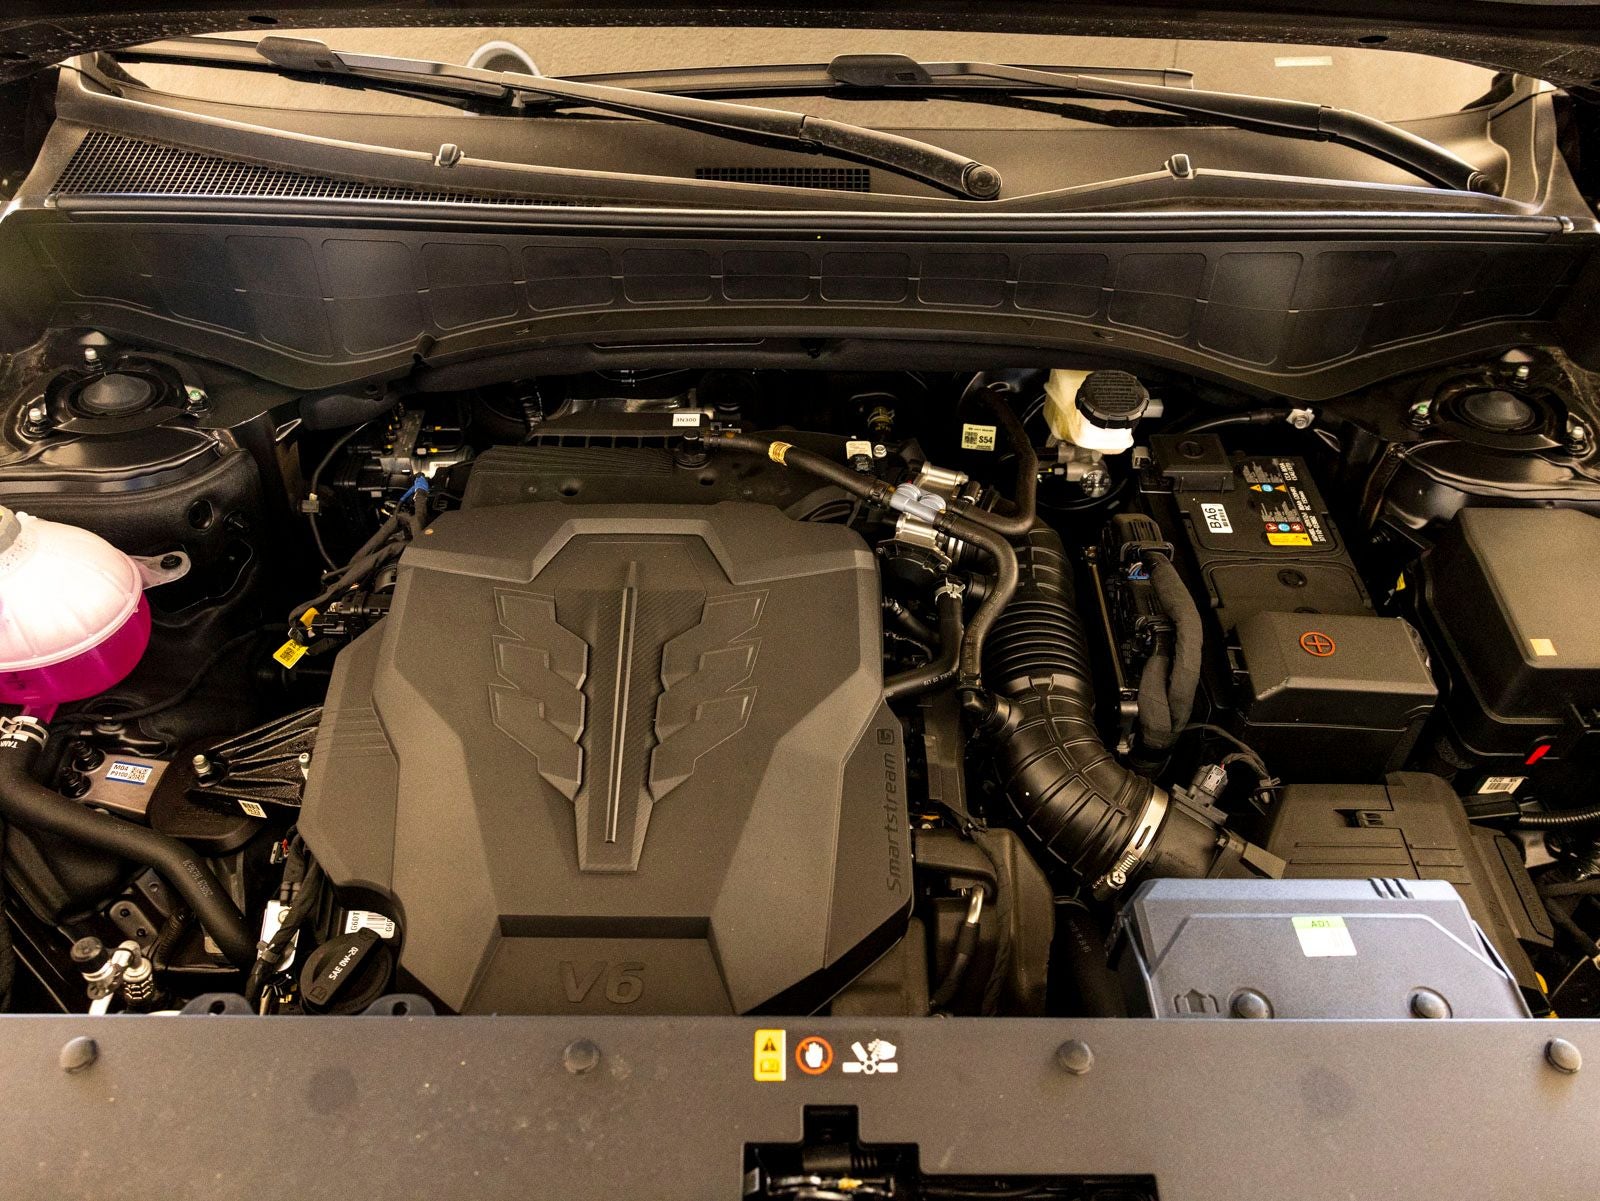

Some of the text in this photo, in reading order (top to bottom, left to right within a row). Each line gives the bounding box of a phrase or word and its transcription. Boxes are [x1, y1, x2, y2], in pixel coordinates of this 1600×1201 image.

[979, 435, 993, 443] S54
[1205, 507, 1222, 529] BA6
[883, 752, 901, 893] Smartstream
[328, 946, 359, 980] SAE 0W-20
[559, 960, 646, 1005] V6
